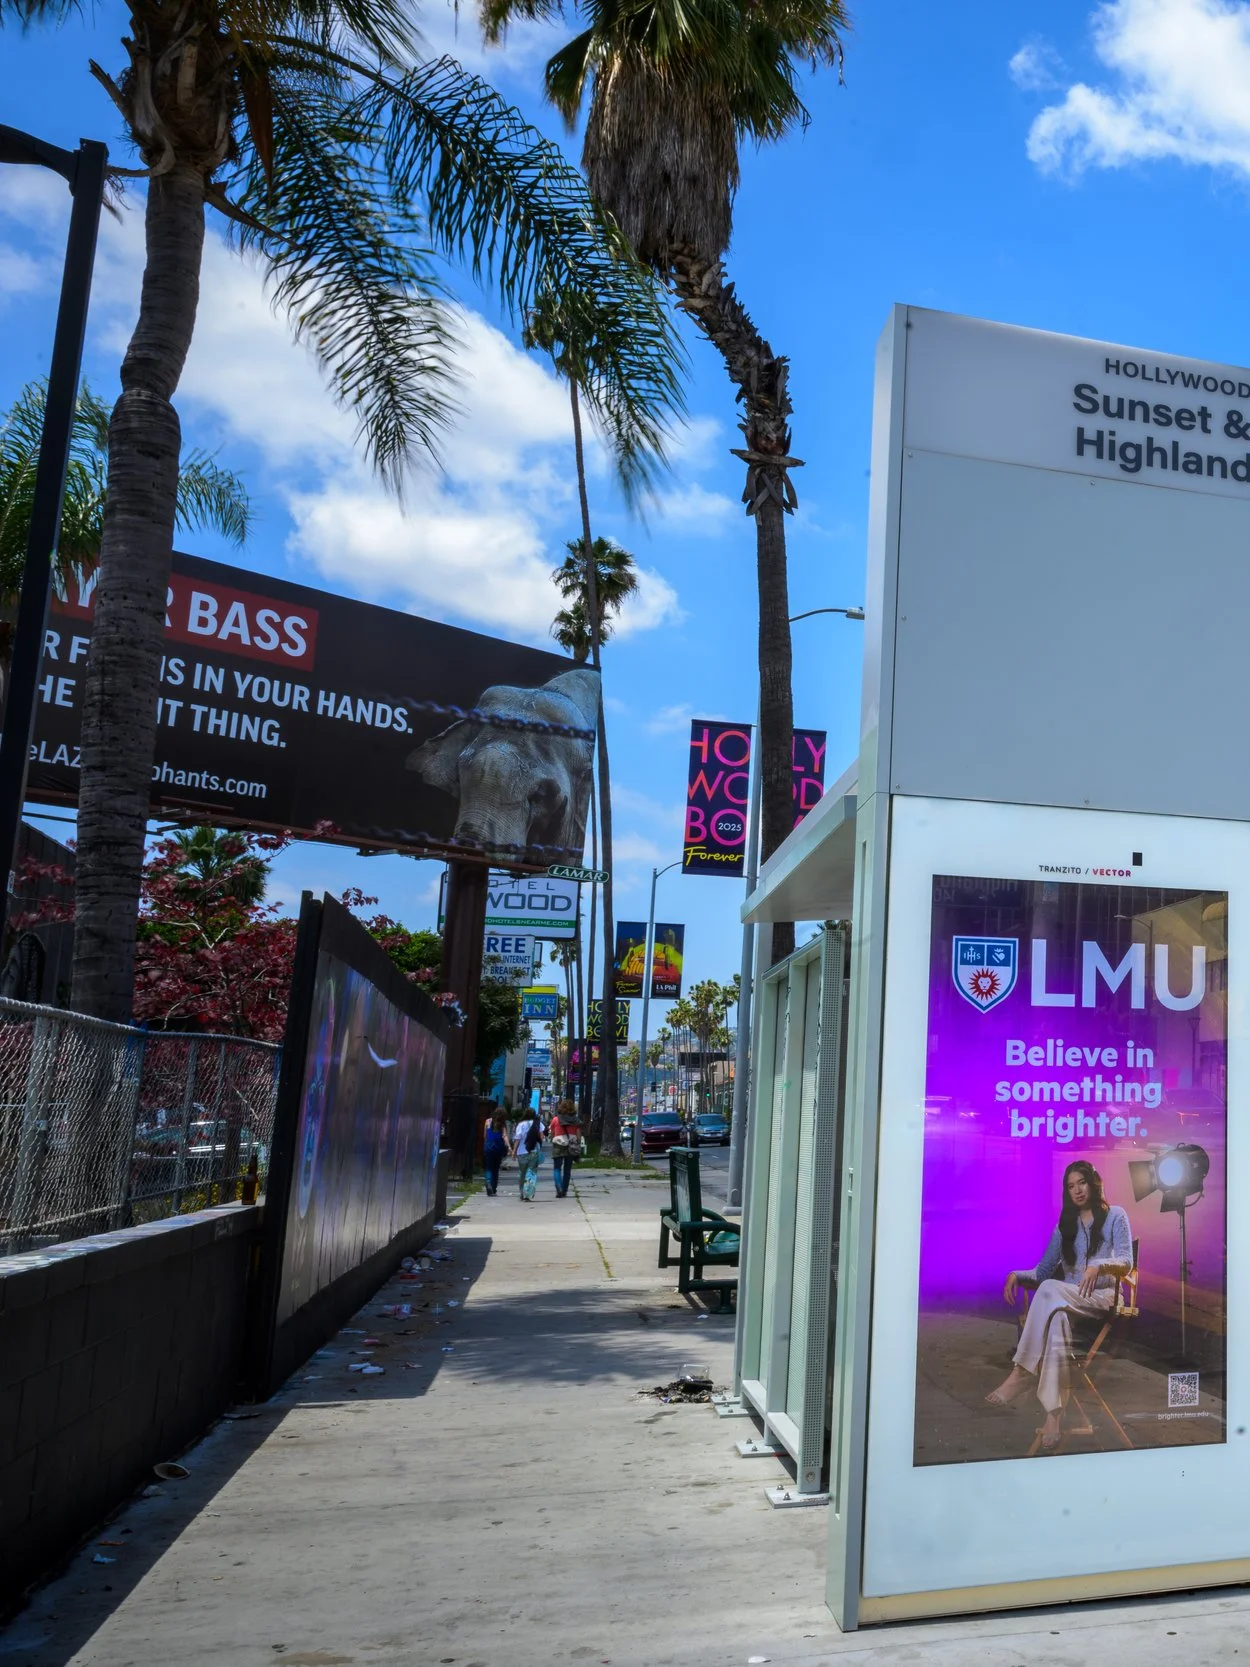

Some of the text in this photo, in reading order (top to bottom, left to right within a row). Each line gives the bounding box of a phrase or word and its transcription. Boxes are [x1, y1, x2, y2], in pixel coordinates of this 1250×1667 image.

[1072, 383, 1212, 434] Sunset
[187, 590, 309, 657] BASS
[38, 674, 77, 708] HE
[192, 662, 225, 695] IN
[233, 671, 311, 713] YOUR
[316, 689, 414, 735] HANDS.
[190, 703, 287, 749] THING.
[717, 822, 742, 832] 2025
[684, 846, 745, 867] Forever
[552, 866, 604, 881] LAMAR
[1038, 865, 1082, 875] TRANZITO
[1092, 868, 1131, 877] VECTOR
[486, 879, 556, 891] OTEL
[486, 892, 573, 912] WOOD
[486, 936, 527, 954] REE
[502, 955, 531, 964] INTERNET
[1030, 938, 1206, 1011] LMU
[524, 1004, 555, 1014] INN
[1006, 1038, 1154, 1068] Believe in
[995, 1074, 1162, 1108] something
[1010, 1108, 1148, 1144] brighter.
